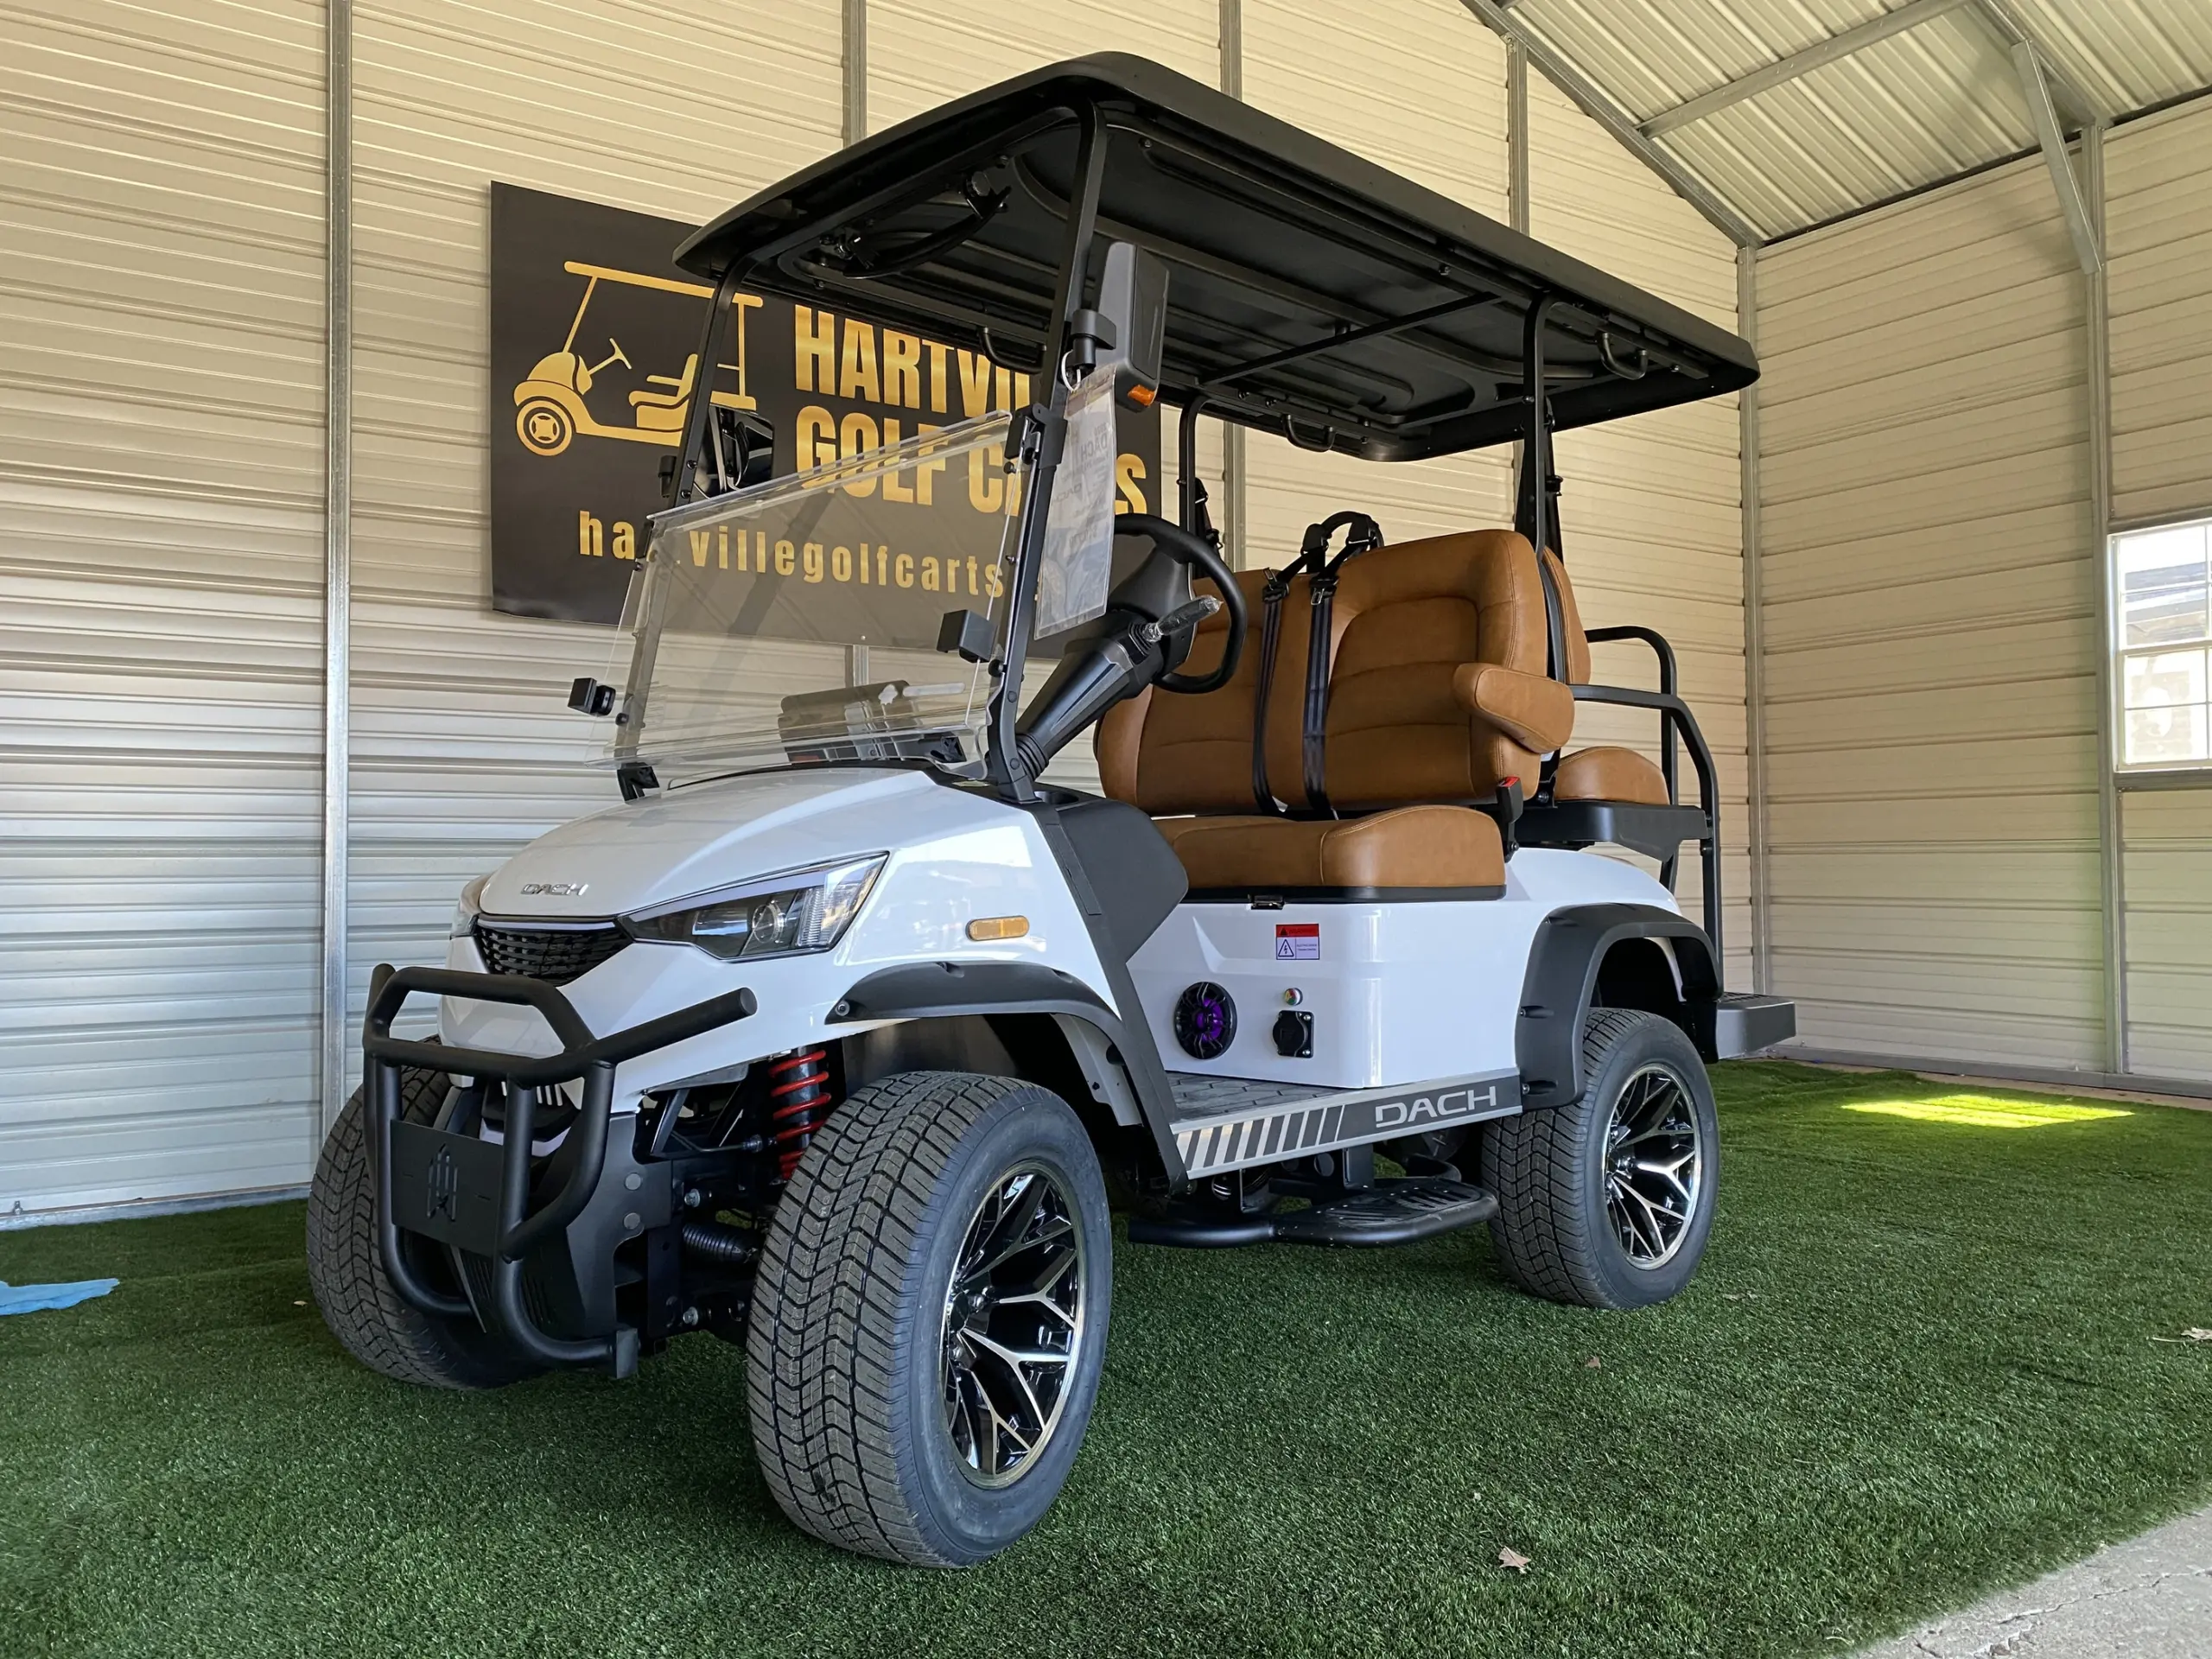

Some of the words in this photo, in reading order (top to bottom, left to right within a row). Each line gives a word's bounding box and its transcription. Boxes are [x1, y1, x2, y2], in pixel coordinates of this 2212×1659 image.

[794, 303, 1030, 418] HARTVI
[796, 404, 949, 506] GOLF
[579, 510, 1004, 599] havillegolfcarts
[520, 883, 589, 896] DACH
[1375, 1085, 1497, 1128] DACH
